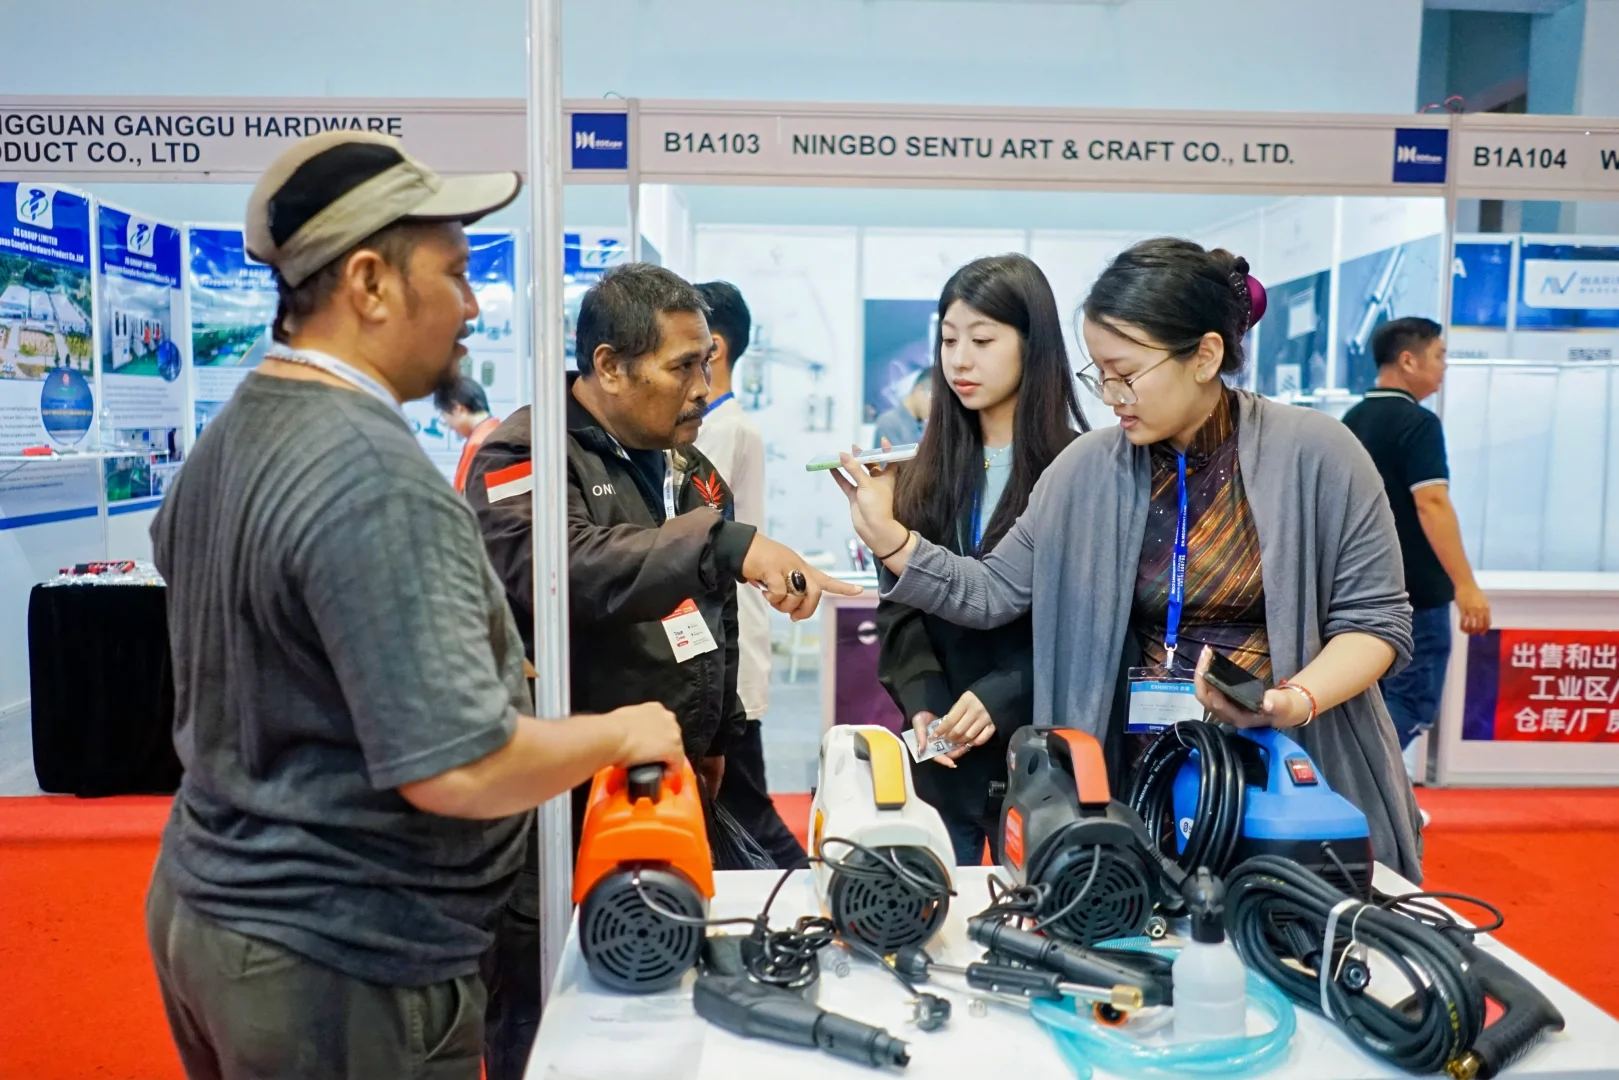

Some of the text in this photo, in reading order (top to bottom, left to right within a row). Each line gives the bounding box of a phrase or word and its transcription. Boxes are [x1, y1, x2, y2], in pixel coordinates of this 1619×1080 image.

[0, 114, 403, 138] GGUAN GANGGU HARDWARE
[0, 141, 200, 166] DUCT CO., LTD
[664, 132, 760, 154] B1A103
[792, 134, 1295, 166] NINGBO SENTU ART & CRAFT CO., LTD.
[1473, 146, 1567, 169] B1A104
[21, 229, 37, 241] GROUP
[39, 233, 57, 246] LIMITED
[1511, 642, 1617, 669] 出售和出
[1528, 675, 1619, 703] 工业区/
